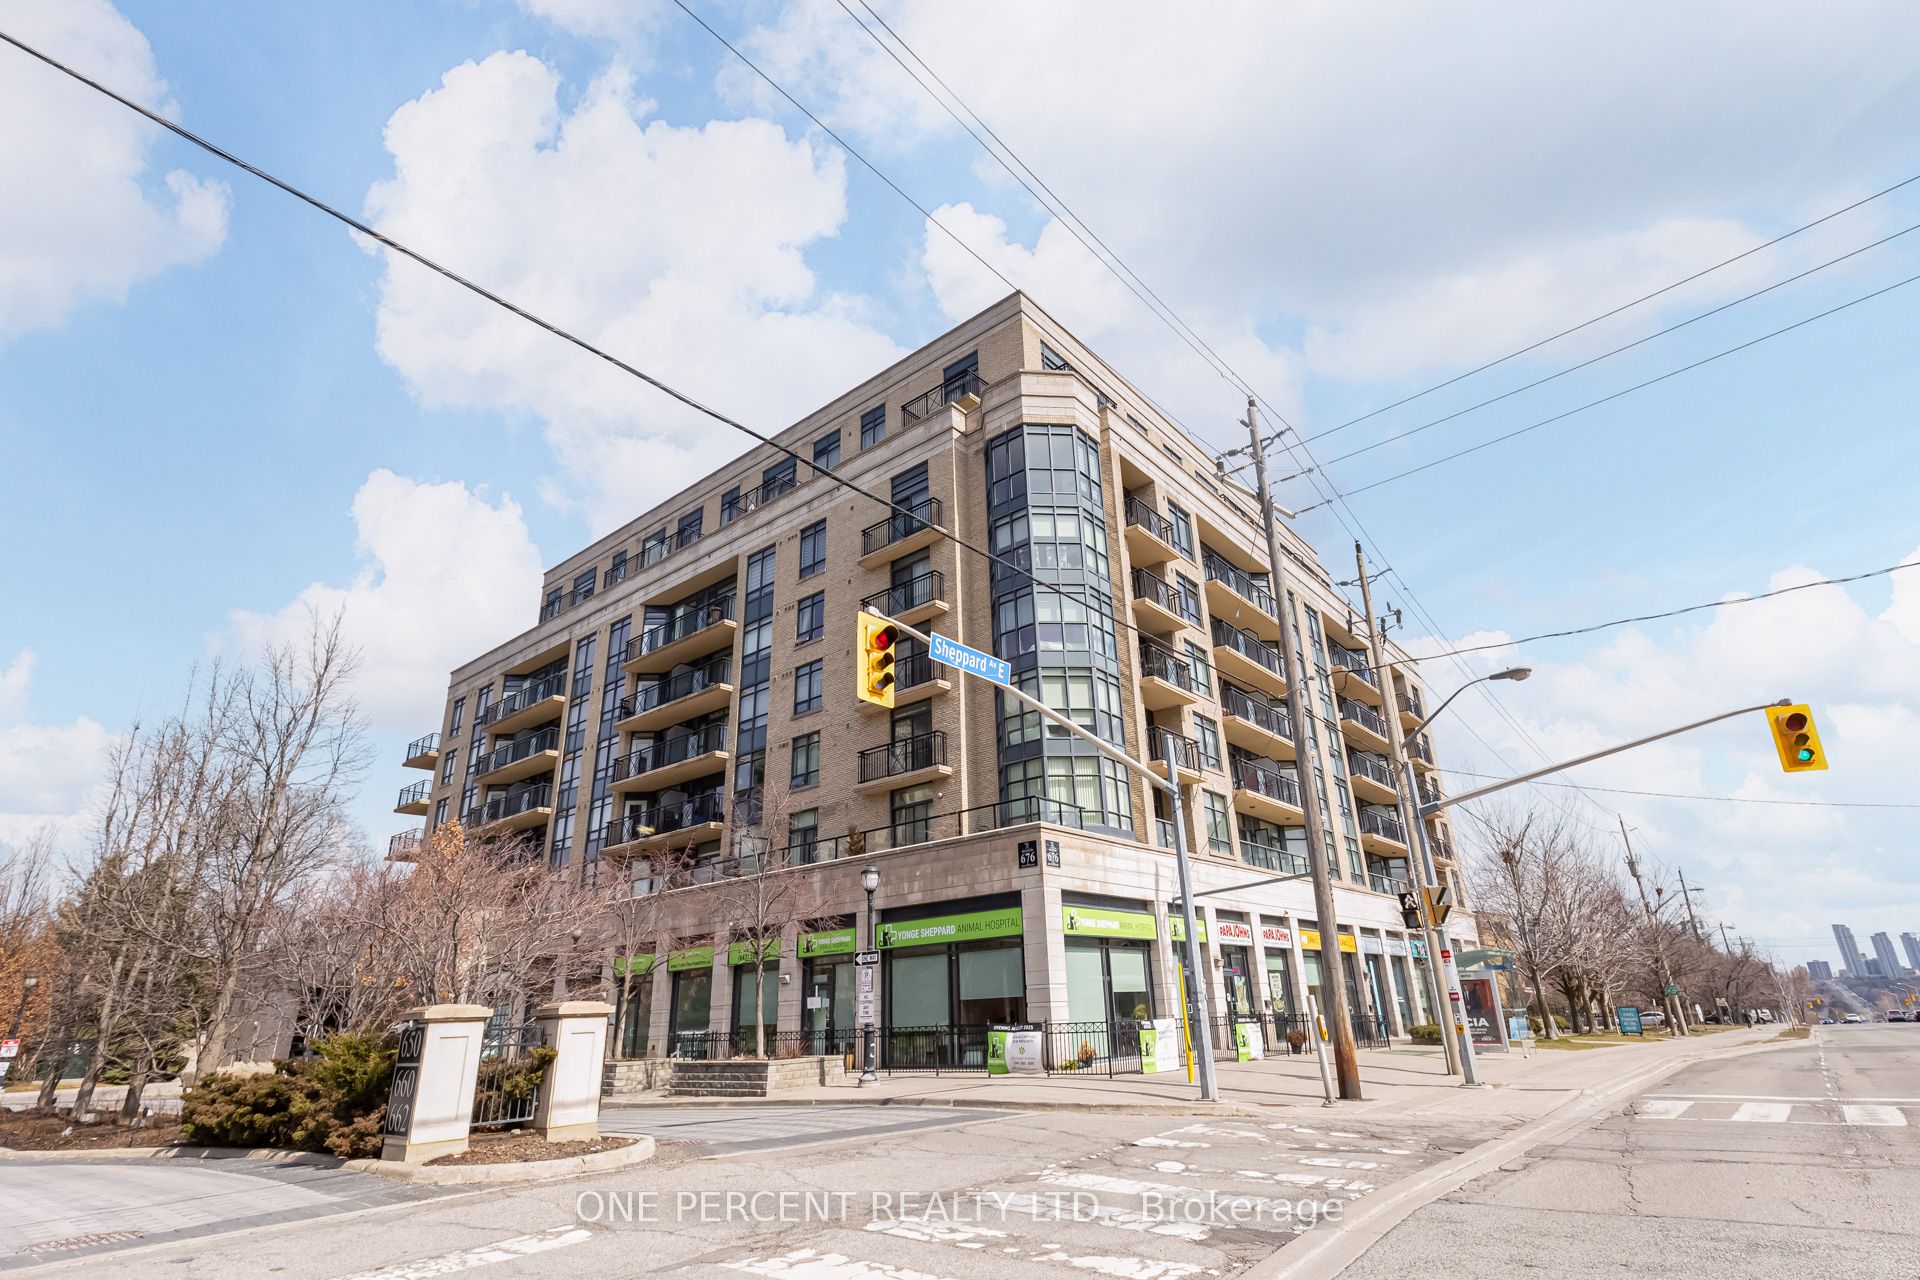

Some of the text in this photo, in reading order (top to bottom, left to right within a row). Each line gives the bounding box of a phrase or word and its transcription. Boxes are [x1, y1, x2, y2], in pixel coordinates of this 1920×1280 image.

[934, 637, 987, 672] Sheppard
[998, 663, 1005, 679] E
[1020, 851, 1036, 864] 676
[1047, 851, 1059, 863] 676
[897, 917, 1020, 940] YONGE SHEPPARD ANIMAL HOSPITAL
[1219, 924, 1233, 937] PAPA
[1263, 928, 1275, 940] PAPA
[401, 1030, 422, 1058] 650
[394, 1069, 416, 1098] 660
[388, 1103, 410, 1132] 662
